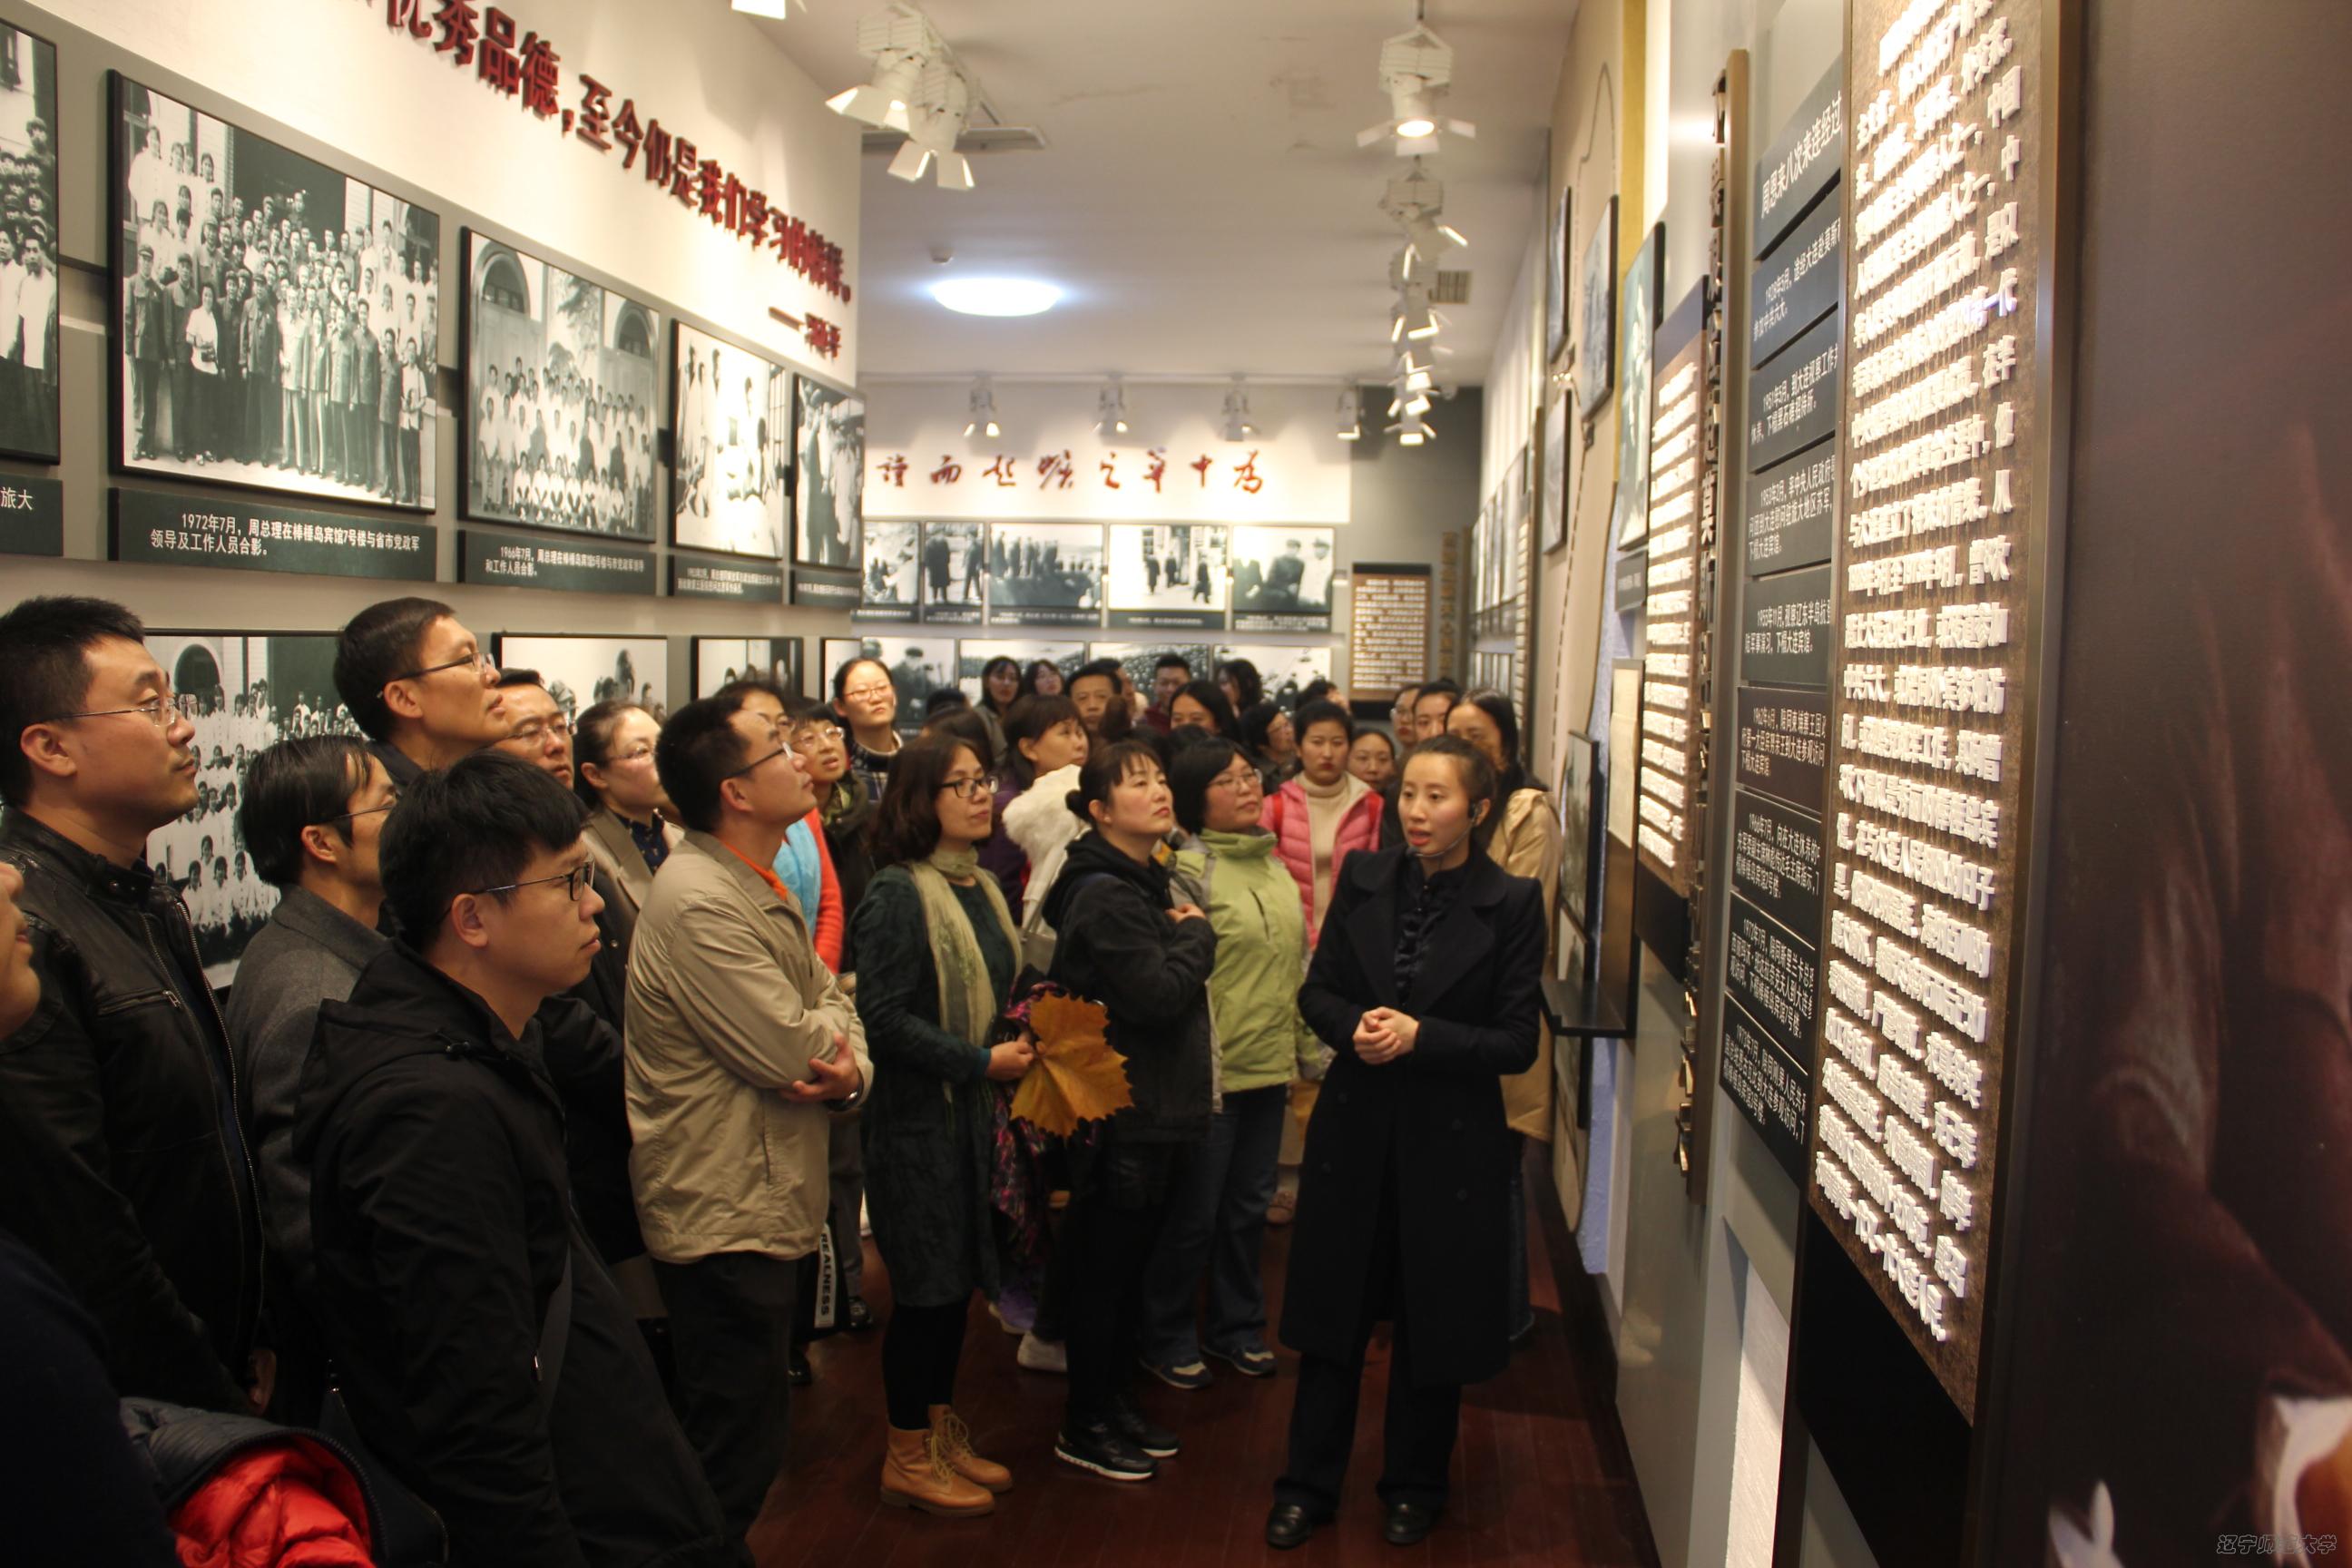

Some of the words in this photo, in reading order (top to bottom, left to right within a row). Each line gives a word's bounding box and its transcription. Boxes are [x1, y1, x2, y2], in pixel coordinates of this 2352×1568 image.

[0, 485, 34, 511] 旅大
[150, 528, 269, 556] 领导及工作人员合影。
[820, 1233, 832, 1316] REALNESS
